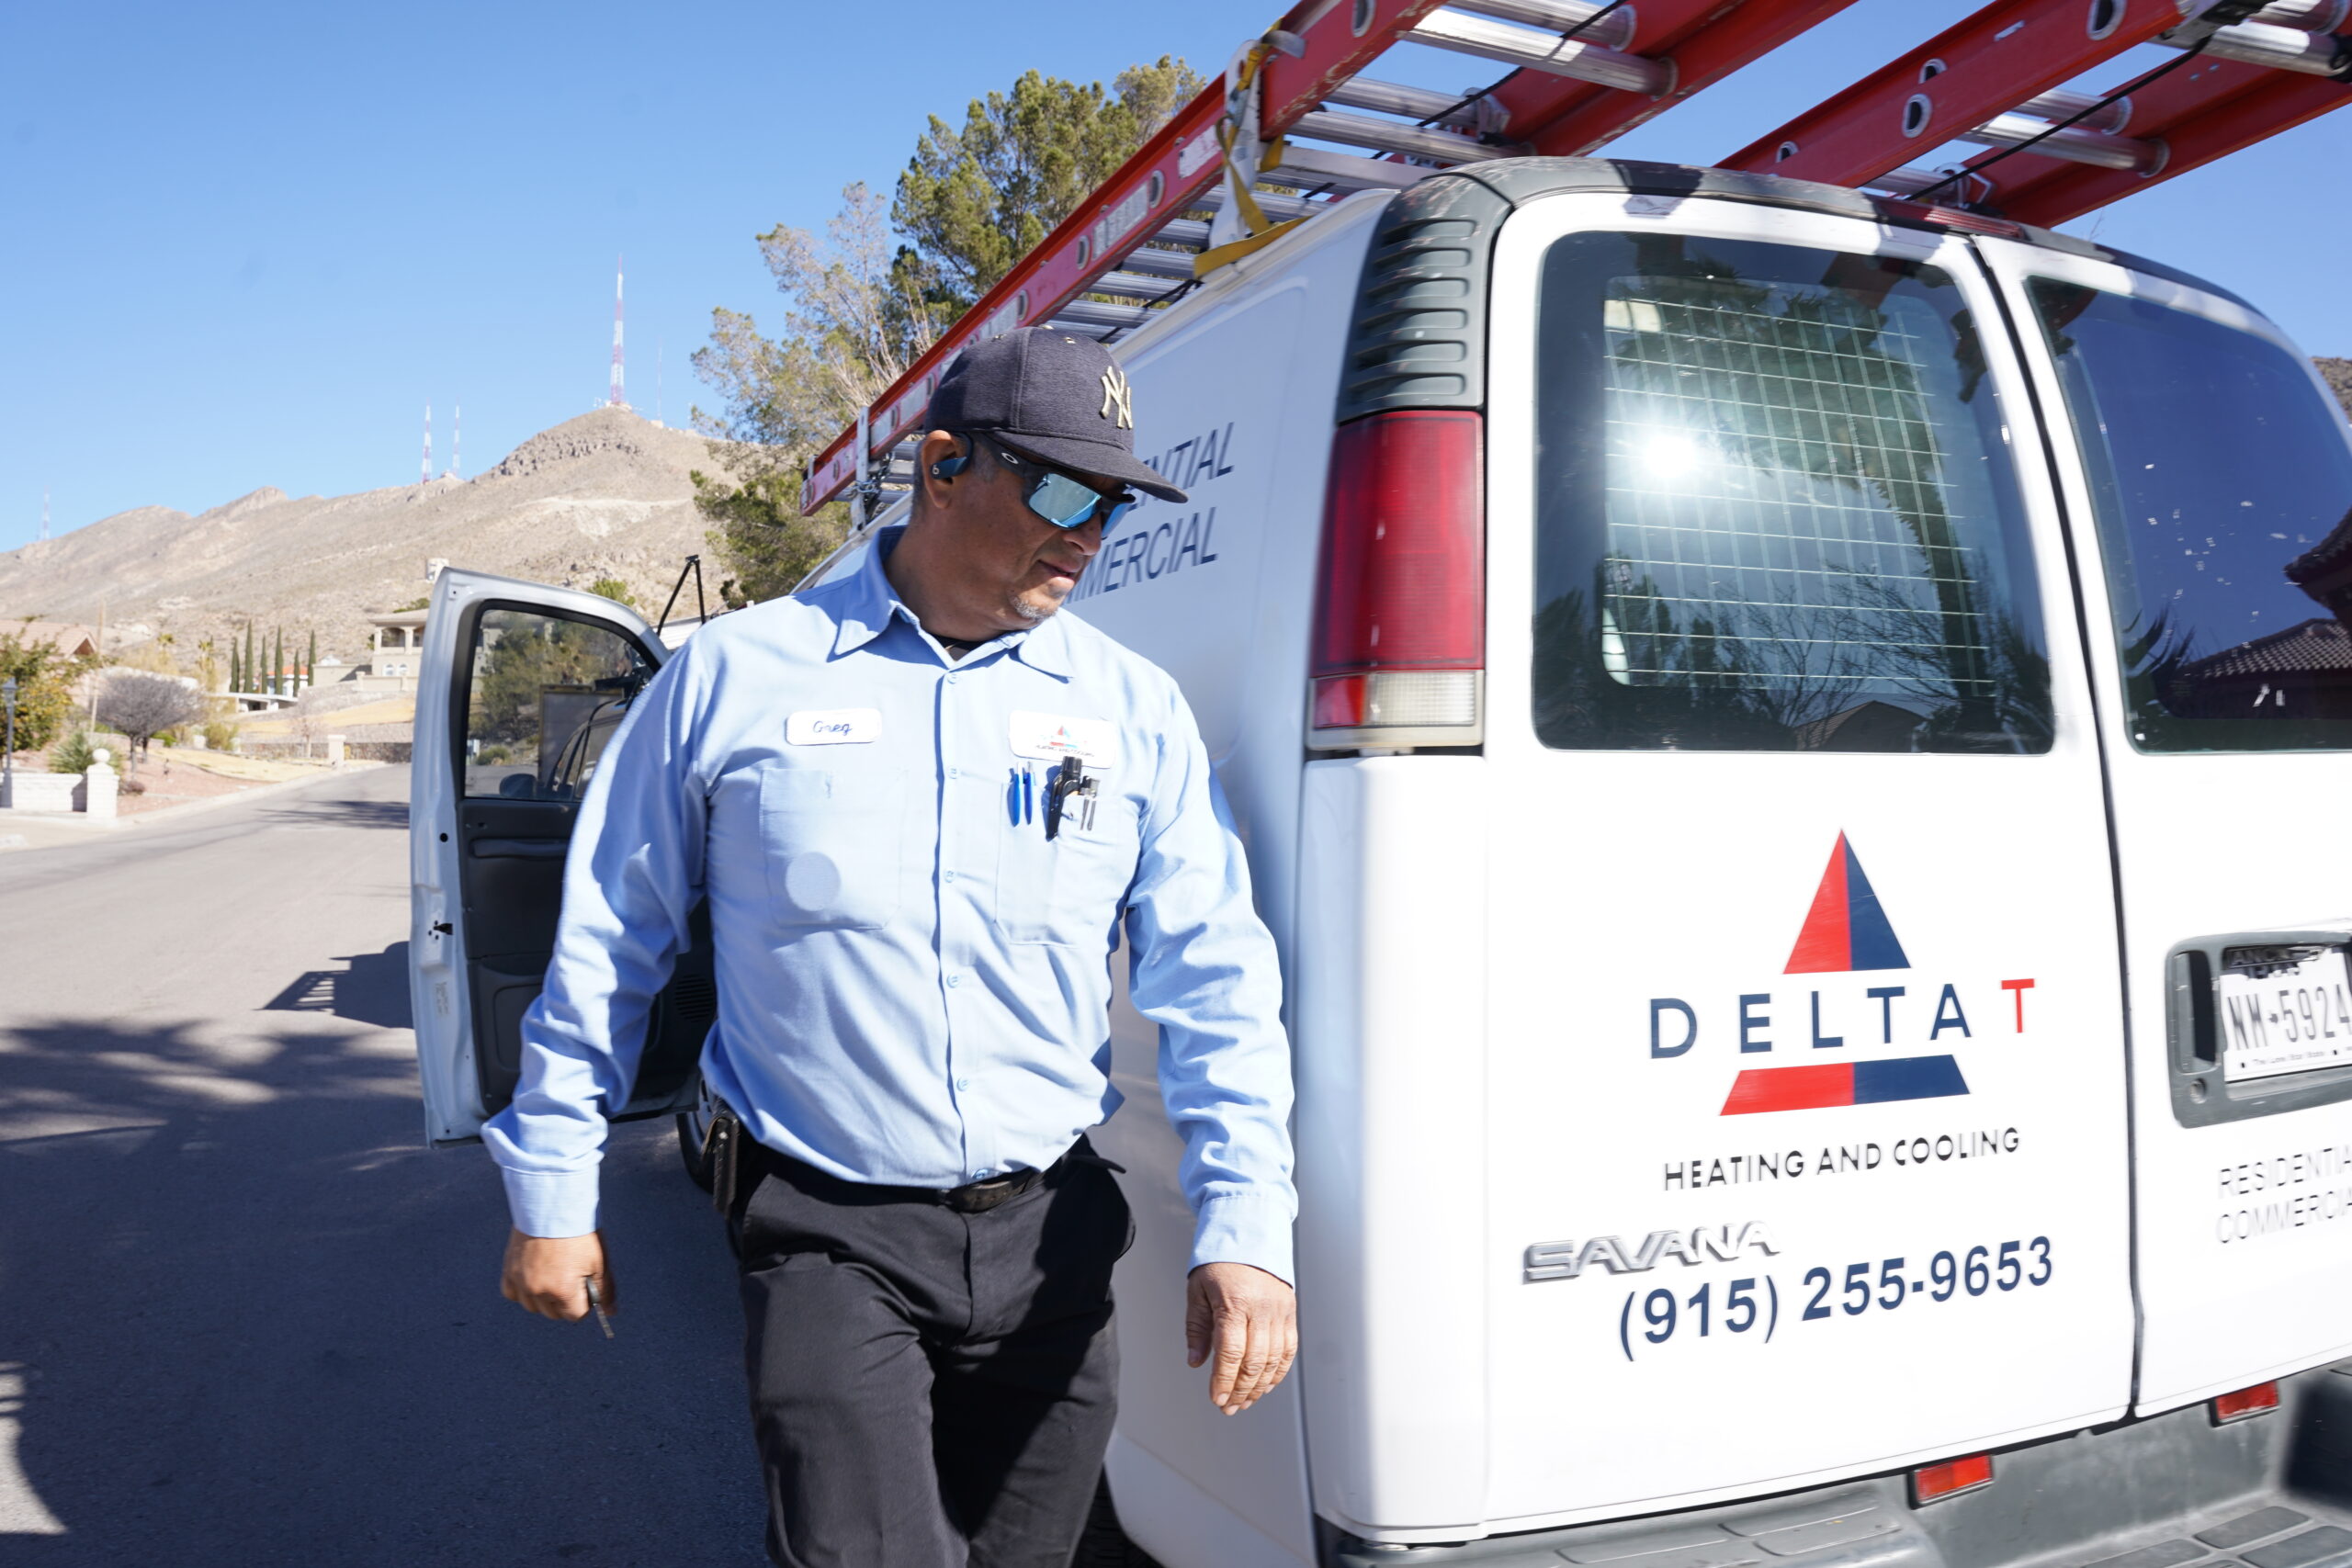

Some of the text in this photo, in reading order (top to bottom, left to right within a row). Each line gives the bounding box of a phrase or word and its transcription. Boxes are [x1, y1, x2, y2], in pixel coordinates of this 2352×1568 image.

[813, 720, 853, 736] Greg
[1649, 978, 2035, 1059] DELTA T
[1665, 1127, 2019, 1191] HEATING AND COOLING
[1521, 1220, 1781, 1285] SAVANA
[1620, 1235, 2052, 1361] (915) 255-9653
